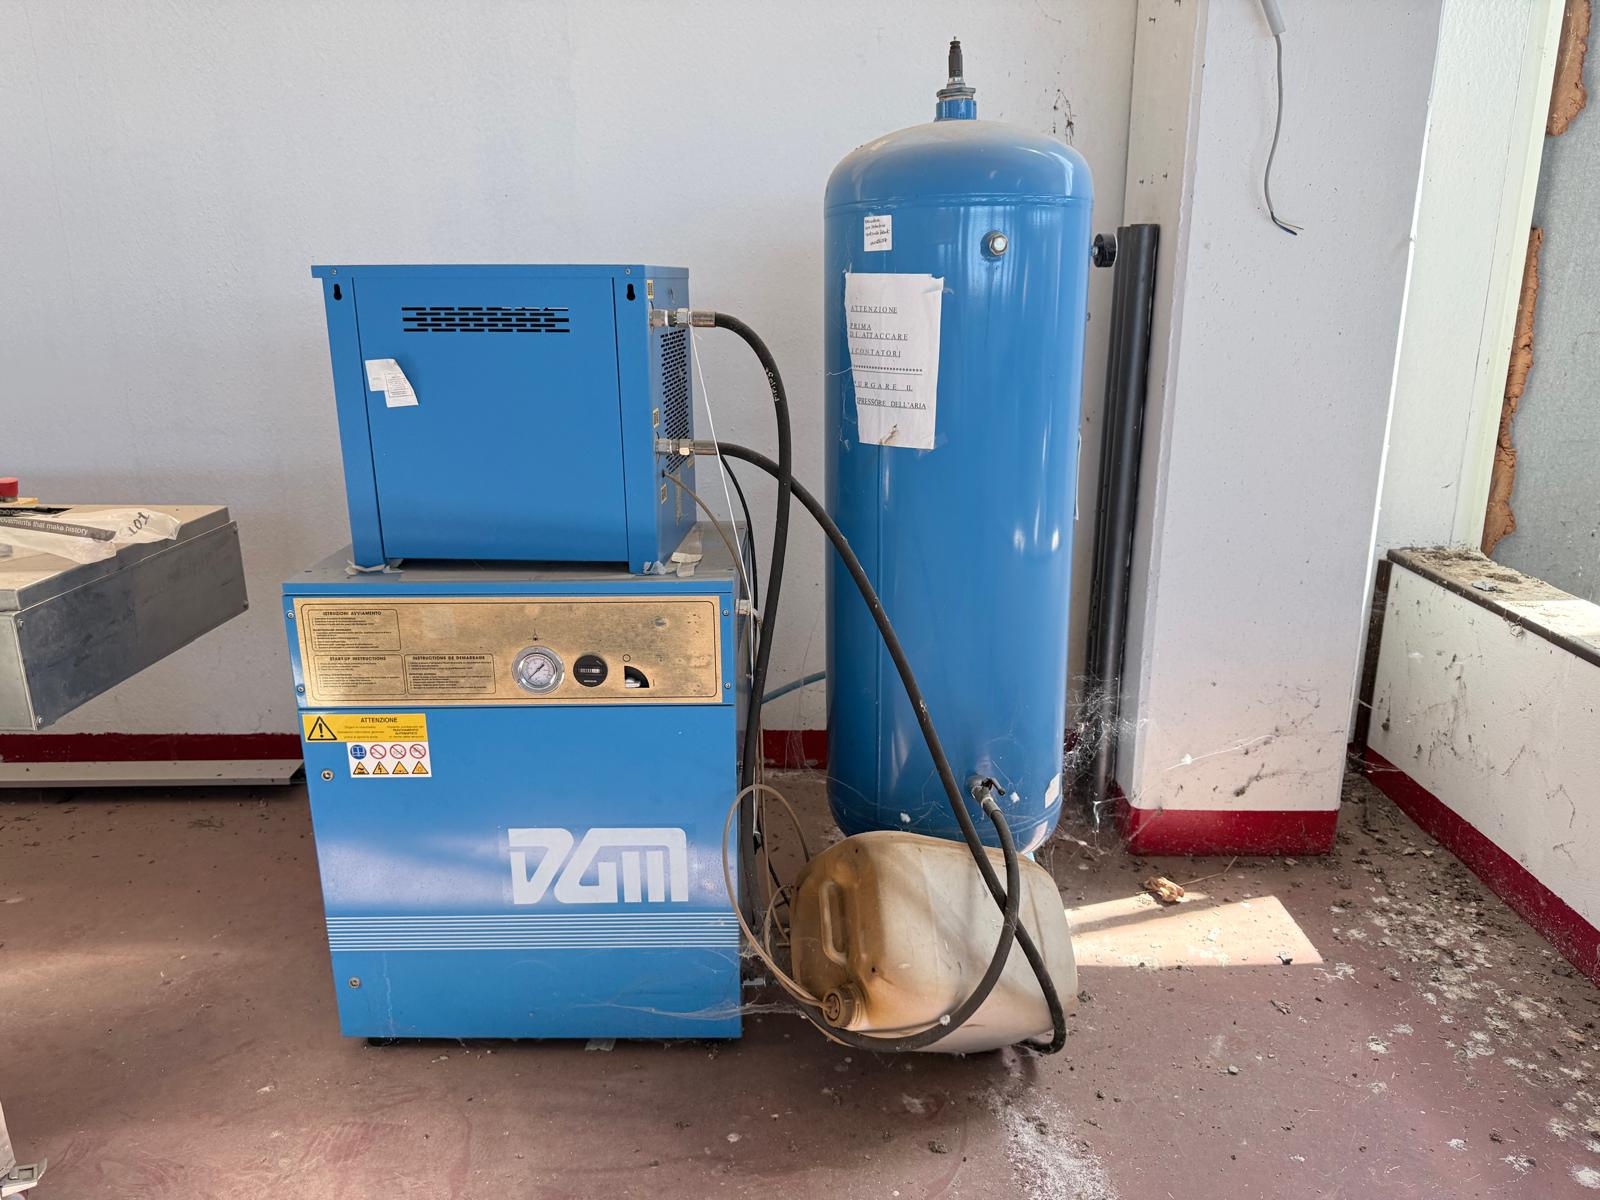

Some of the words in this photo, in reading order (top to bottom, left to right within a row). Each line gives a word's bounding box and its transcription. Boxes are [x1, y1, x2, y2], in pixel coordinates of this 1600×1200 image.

[850, 305, 898, 314] ATTENZIONE
[849, 322, 872, 331] PRIMA
[849, 331, 858, 339] DI
[862, 331, 908, 341] ATTACCARE
[906, 384, 913, 392] IL
[890, 400, 927, 410] DELL'ARIA
[32, 519, 46, 529] that
[46, 523, 64, 532] make
[65, 525, 89, 536] history
[360, 716, 398, 724] ATTENZIONE
